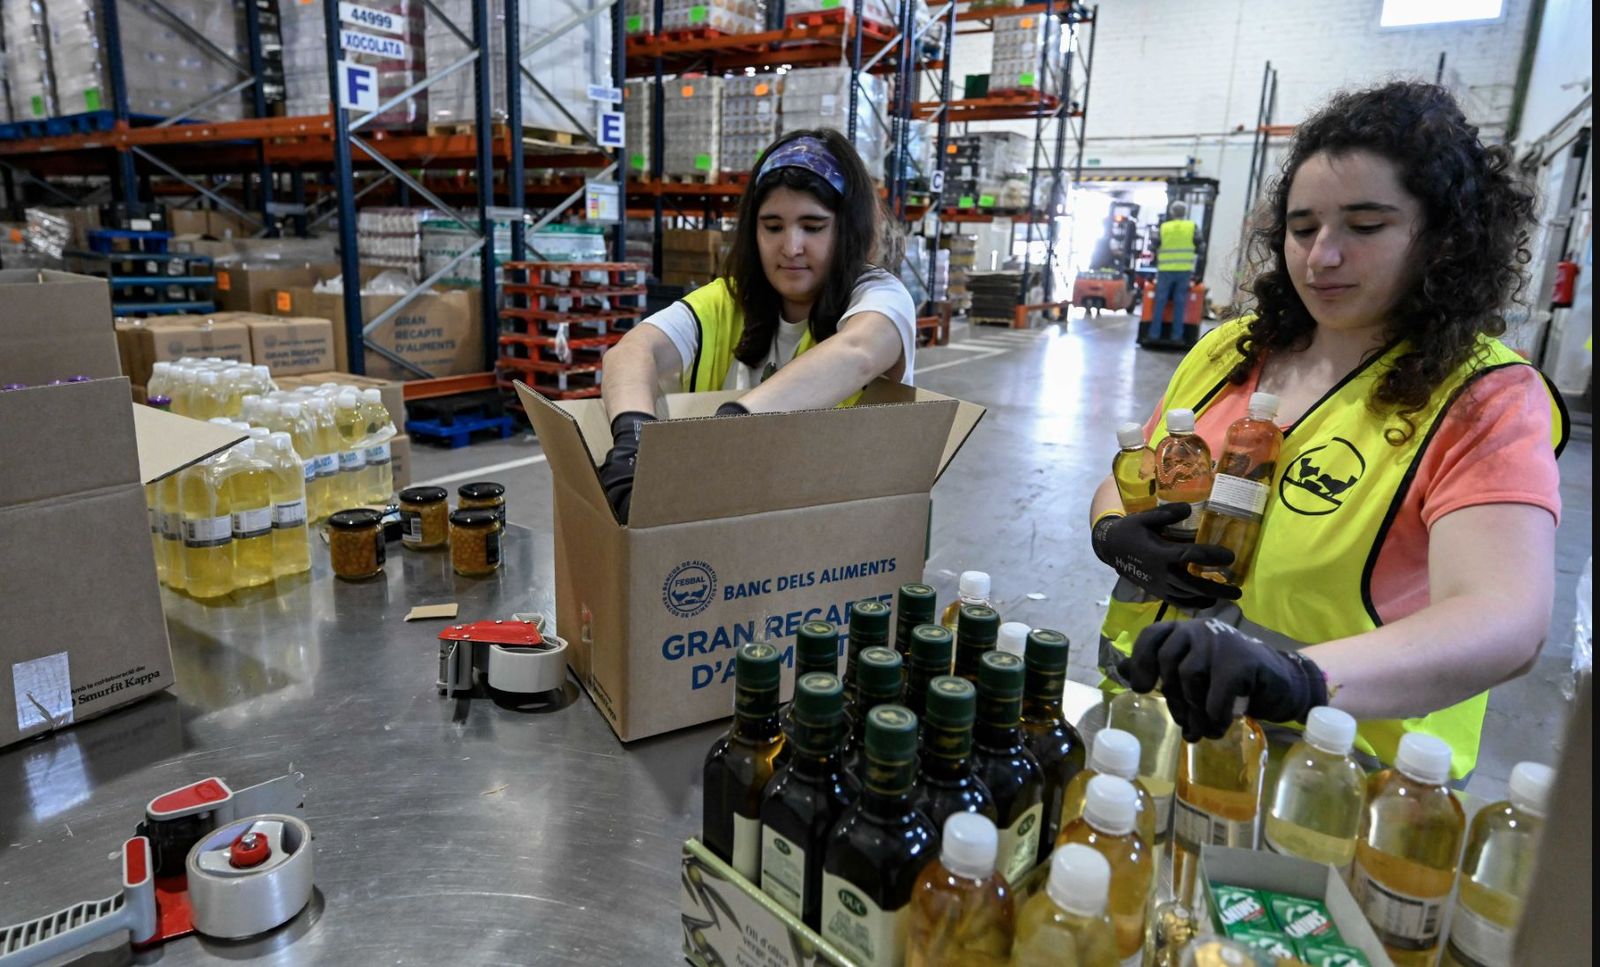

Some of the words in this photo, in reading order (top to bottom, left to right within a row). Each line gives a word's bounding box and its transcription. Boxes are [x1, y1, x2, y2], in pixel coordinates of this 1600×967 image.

[351, 8, 393, 29] 44999
[345, 33, 402, 56] XOCOLATA
[347, 67, 370, 105] F
[603, 114, 621, 143] E
[933, 173, 942, 189] C
[675, 576, 706, 587] FESBAL
[724, 578, 772, 601] BANC
[777, 572, 815, 592] DELS
[820, 557, 897, 584] ALIMENTS
[1115, 556, 1149, 582] HyFlex
[662, 621, 755, 661] GRAN
[78, 681, 123, 705] Smurfit
[124, 670, 161, 688] Kappa
